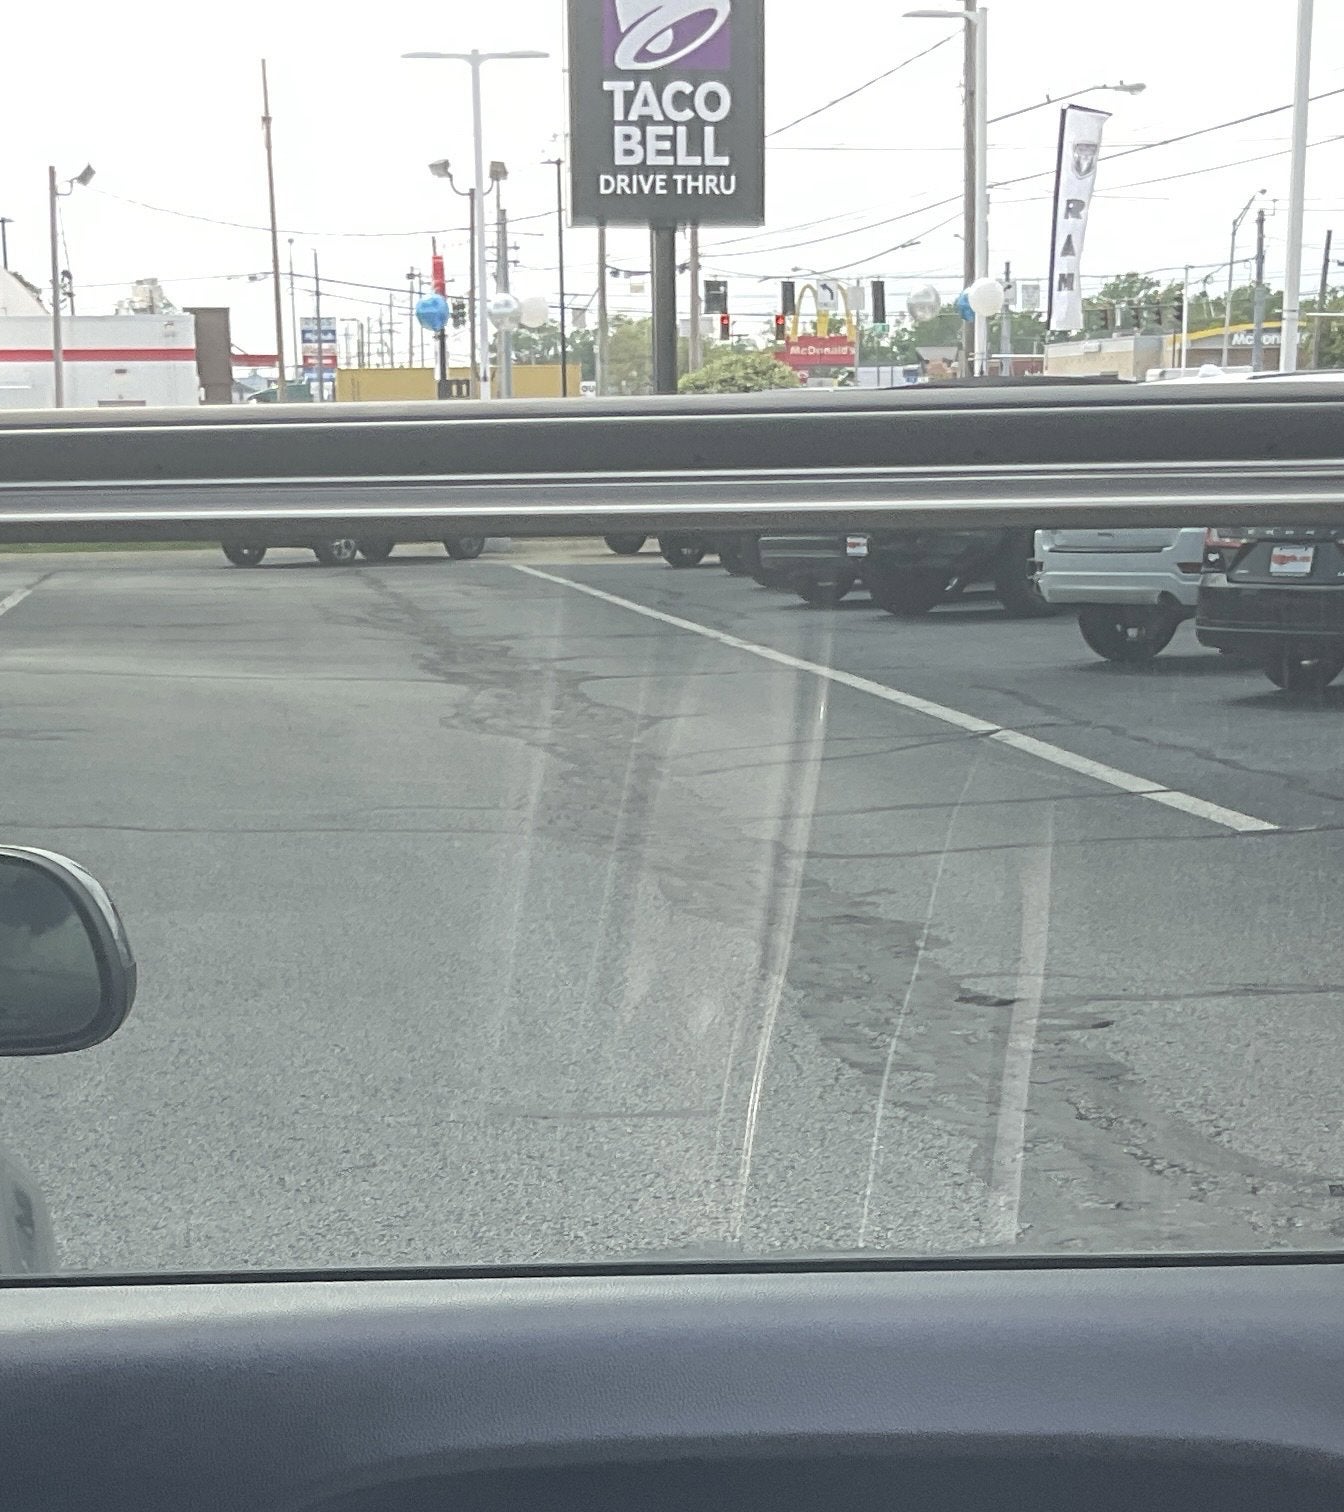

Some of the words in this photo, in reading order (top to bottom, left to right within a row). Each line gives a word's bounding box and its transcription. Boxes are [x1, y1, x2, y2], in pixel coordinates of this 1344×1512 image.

[602, 80, 732, 122] TACO
[613, 125, 730, 166] BELL
[599, 174, 668, 195] DRIVE
[672, 174, 736, 195] THRU
[1057, 198, 1086, 291] RAM
